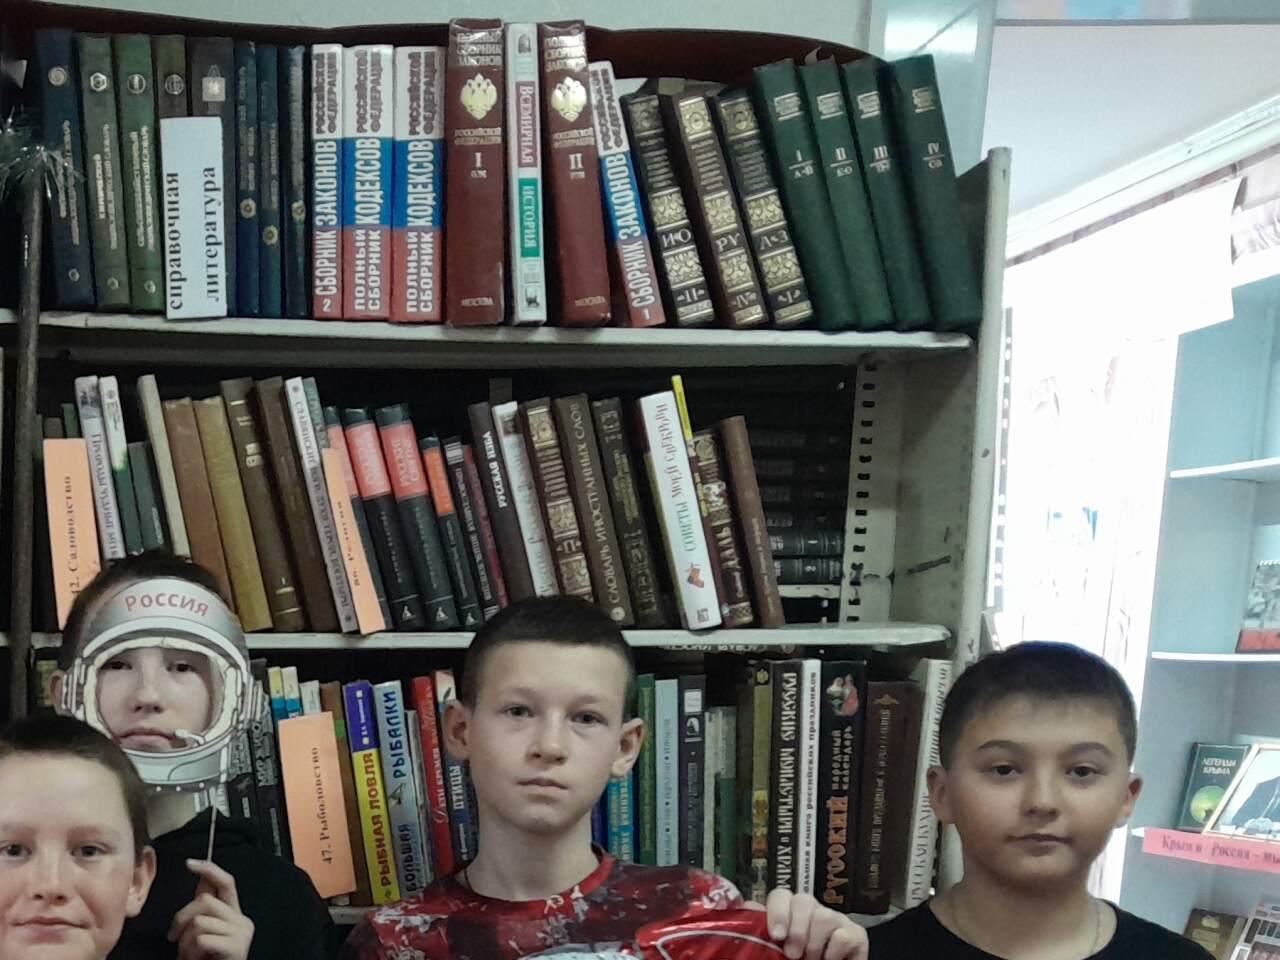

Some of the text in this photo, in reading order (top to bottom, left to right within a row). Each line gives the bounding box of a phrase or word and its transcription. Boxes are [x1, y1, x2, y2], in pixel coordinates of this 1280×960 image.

[519, 84, 535, 166] ВСЕМИРНАЯ
[568, 152, 583, 170] II
[315, 140, 338, 227] ЗАКОНОВ
[354, 137, 384, 226] КОДЕКСОВ
[406, 139, 437, 227] КОДЕКСОВ
[521, 184, 536, 249] ИСТОРИЯ
[604, 152, 642, 239] ЗАКОНОВ
[166, 172, 188, 310] справочная
[201, 167, 224, 303] литература
[315, 230, 338, 296] СБОРНИК
[353, 229, 367, 312] ПОЛНЫЙ
[368, 230, 382, 311] СБОРНИК
[405, 231, 419, 313] ПОЛНЫЙ
[419, 231, 433, 312] СБОРНИК
[620, 239, 656, 308] СБОРНИК
[294, 401, 316, 465] СЛАВЯНСКИЕ
[482, 430, 508, 509] РУССКАЯ ИЗБА
[570, 402, 621, 604] СЛОВАРЬ ИНОСТРАННЫХ СЛОВ
[655, 402, 697, 553] СОВЕТЫ МОЕЙ СВЕКРОВИ
[64, 475, 80, 572] Садоводство
[124, 591, 209, 617] РОССИЯ
[383, 690, 407, 779] РЫБАЛКИ
[809, 672, 818, 742] праздников
[362, 752, 381, 811] ЛОВЛЯ
[449, 764, 465, 810] ПТИЦЫ
[777, 747, 796, 835] МОНАСТЫРИ
[806, 744, 816, 811] российских
[831, 729, 842, 791] НАРОДНЫЙ
[842, 724, 854, 791] КАЛЕНДАРЬ
[1202, 757, 1237, 767] ЛЕГЕНДЫ
[1203, 766, 1231, 775] КРЫМА
[311, 747, 333, 865] 47. Рыболовство
[803, 817, 813, 846] книга
[370, 813, 392, 888] РЫБНАЯ
[399, 823, 417, 892] БОЛЬШАЯ
[775, 845, 793, 892] ХРАМ
[823, 795, 850, 905] РУССКИЙ
[1162, 834, 1193, 853] Крым
[1211, 841, 1250, 859] Россия
